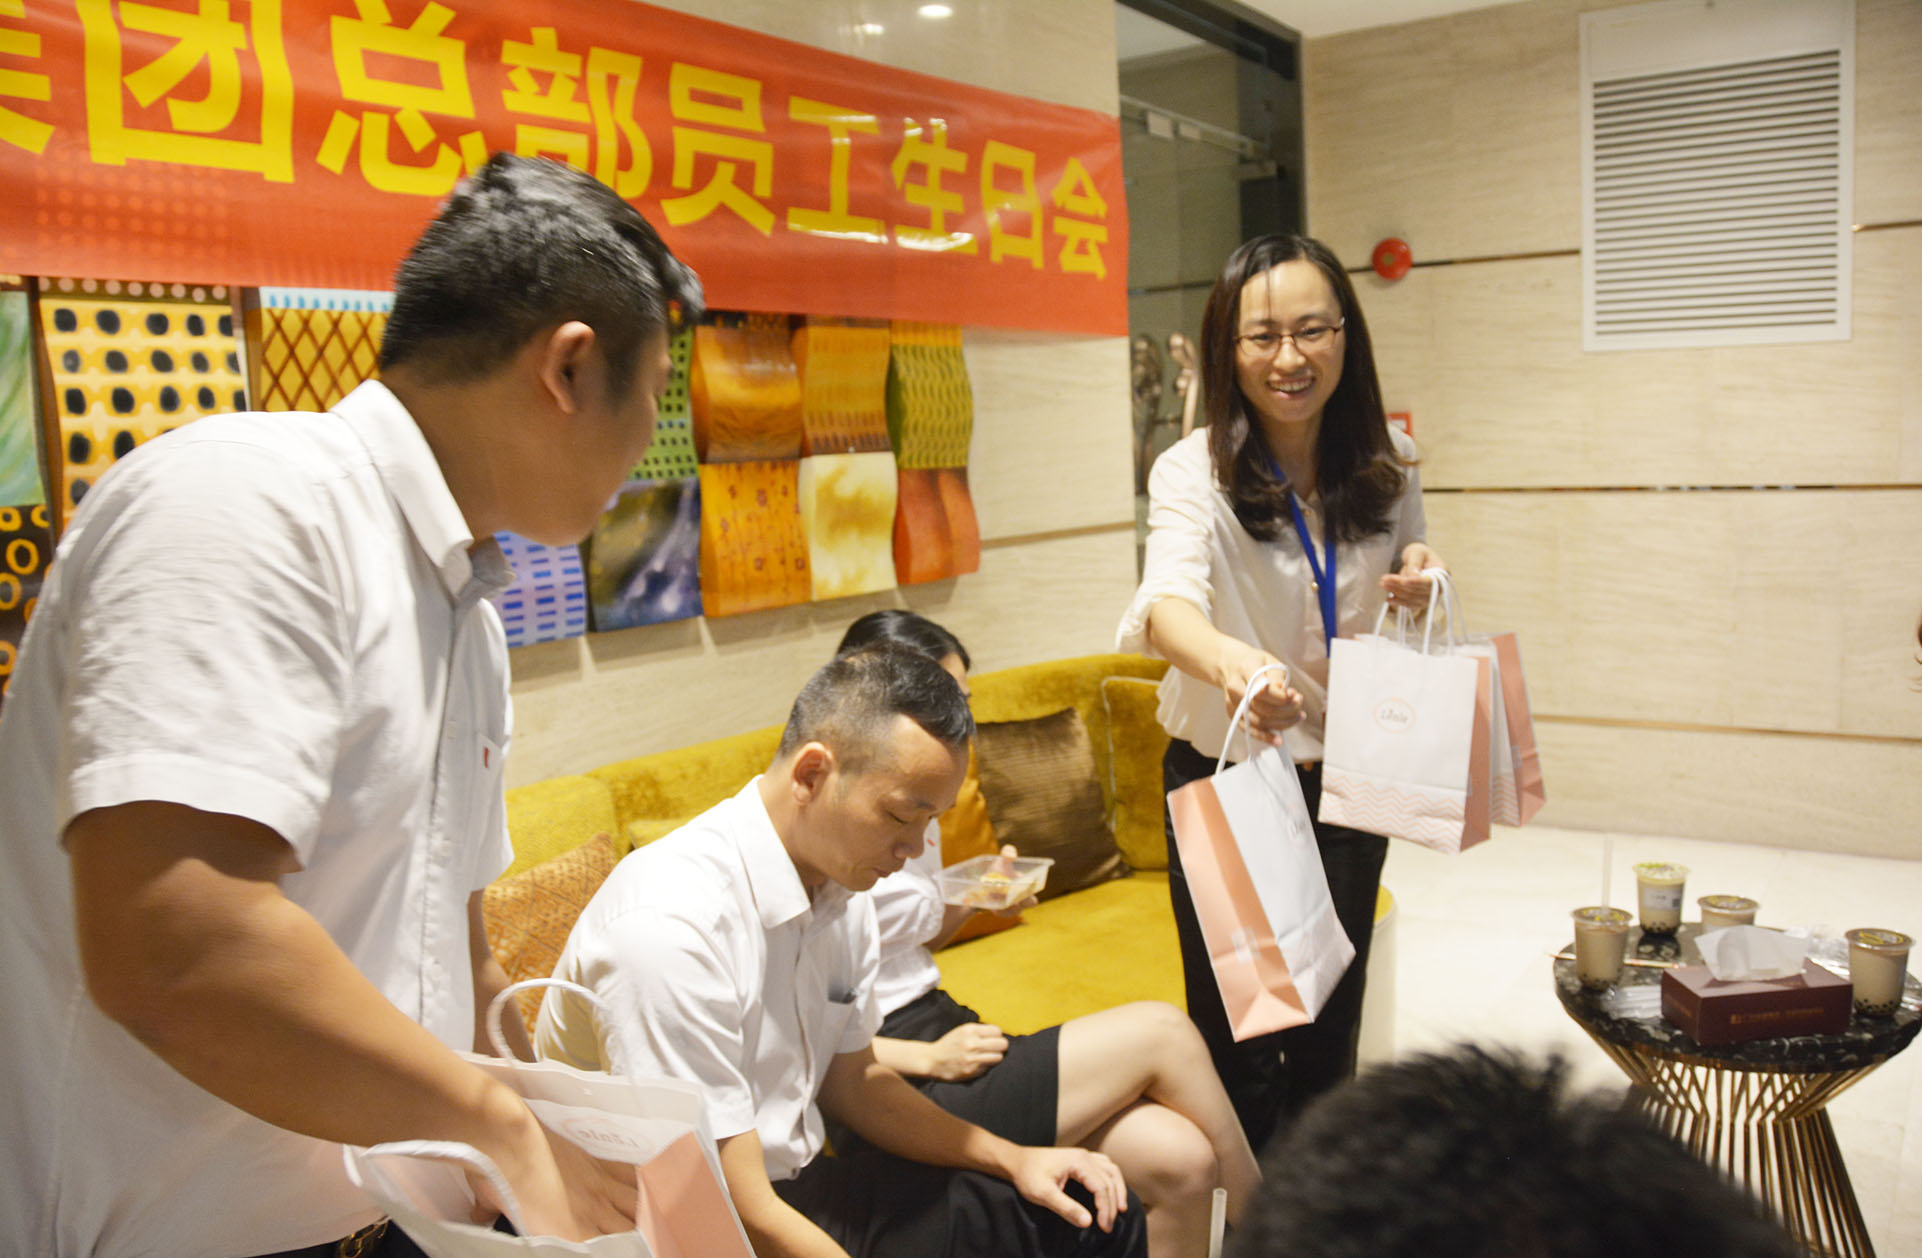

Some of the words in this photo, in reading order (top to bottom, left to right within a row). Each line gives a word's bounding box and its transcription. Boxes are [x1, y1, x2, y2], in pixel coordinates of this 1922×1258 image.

[0, 0, 1107, 279] 团总部员工生日会
